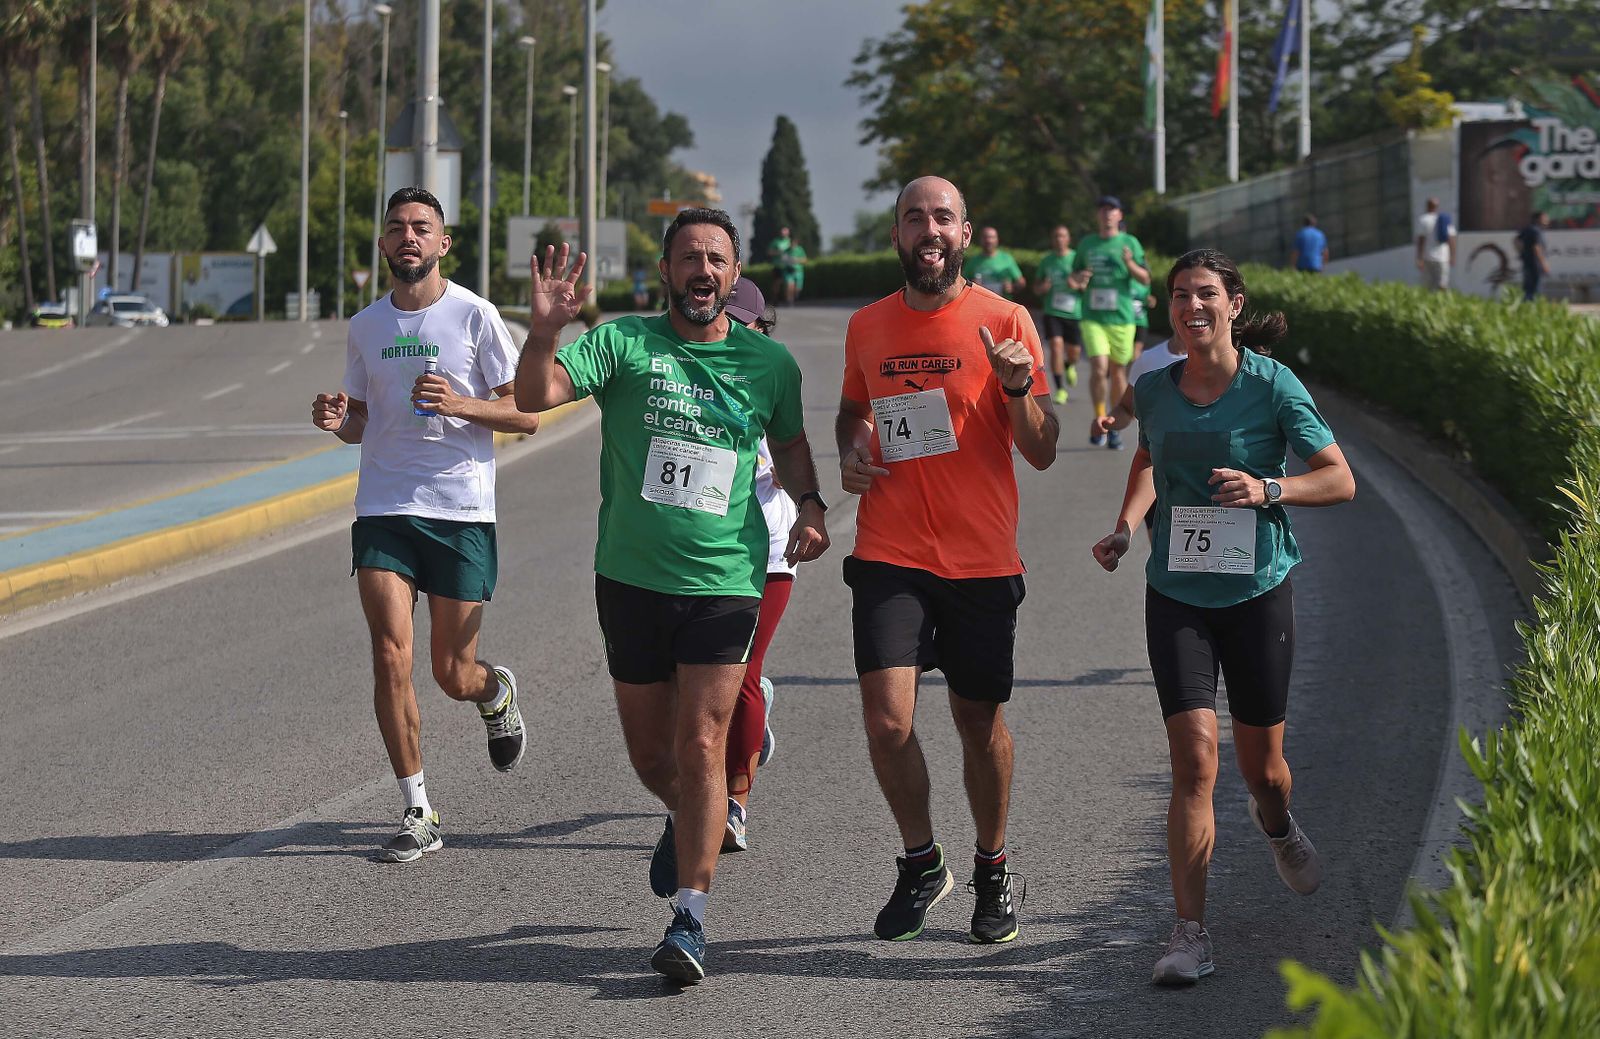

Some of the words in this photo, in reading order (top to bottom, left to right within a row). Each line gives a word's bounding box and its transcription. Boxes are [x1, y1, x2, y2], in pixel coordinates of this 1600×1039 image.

[1532, 118, 1597, 153] The
[651, 358, 673, 374] En
[883, 360, 896, 371] NO
[898, 360, 918, 370] RUN
[921, 359, 955, 370] CARES
[650, 377, 714, 401] marcha
[647, 395, 702, 417] contra
[643, 411, 660, 426] el
[663, 416, 725, 439] cáncer
[883, 416, 912, 443] 74
[660, 460, 692, 488] 81
[1183, 528, 1211, 553] 75
